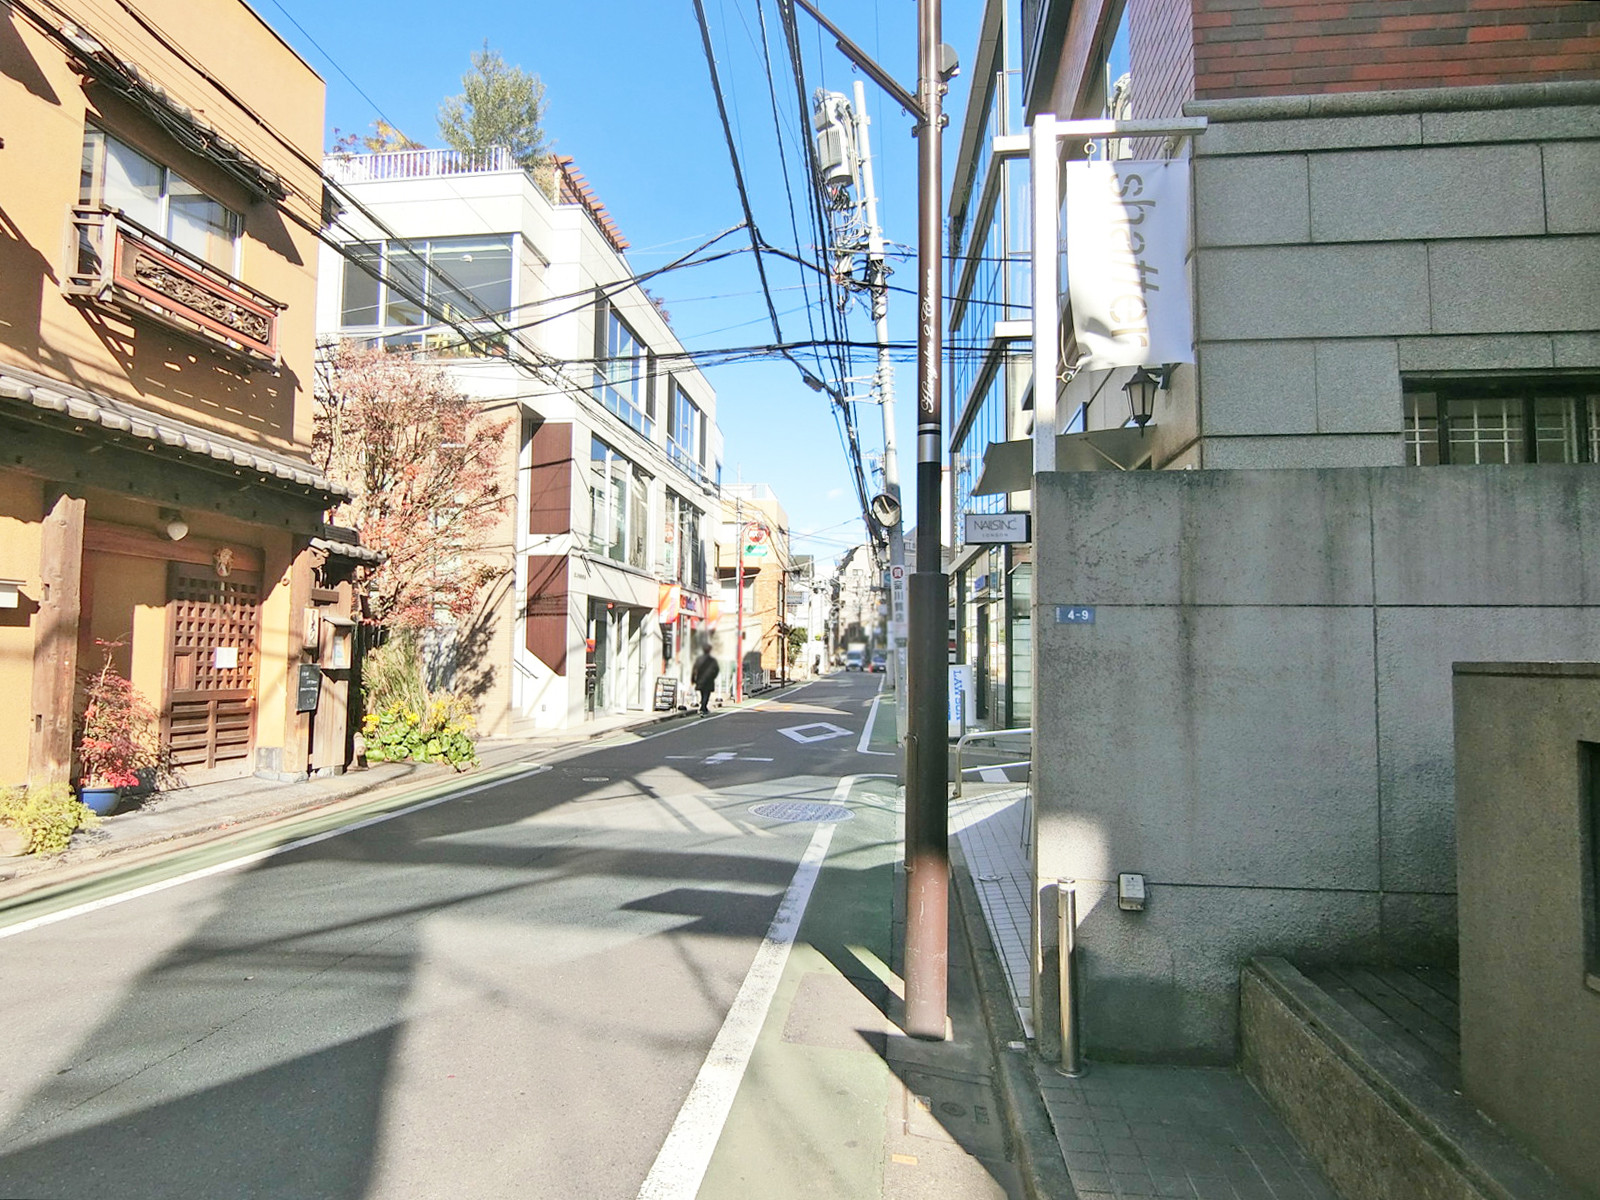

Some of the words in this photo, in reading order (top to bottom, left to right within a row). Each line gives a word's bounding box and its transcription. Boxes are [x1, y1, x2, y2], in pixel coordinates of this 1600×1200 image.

[1110, 173, 1160, 348] shatter
[1067, 609, 1089, 620] 4-9
[952, 669, 963, 721] LAWSON
